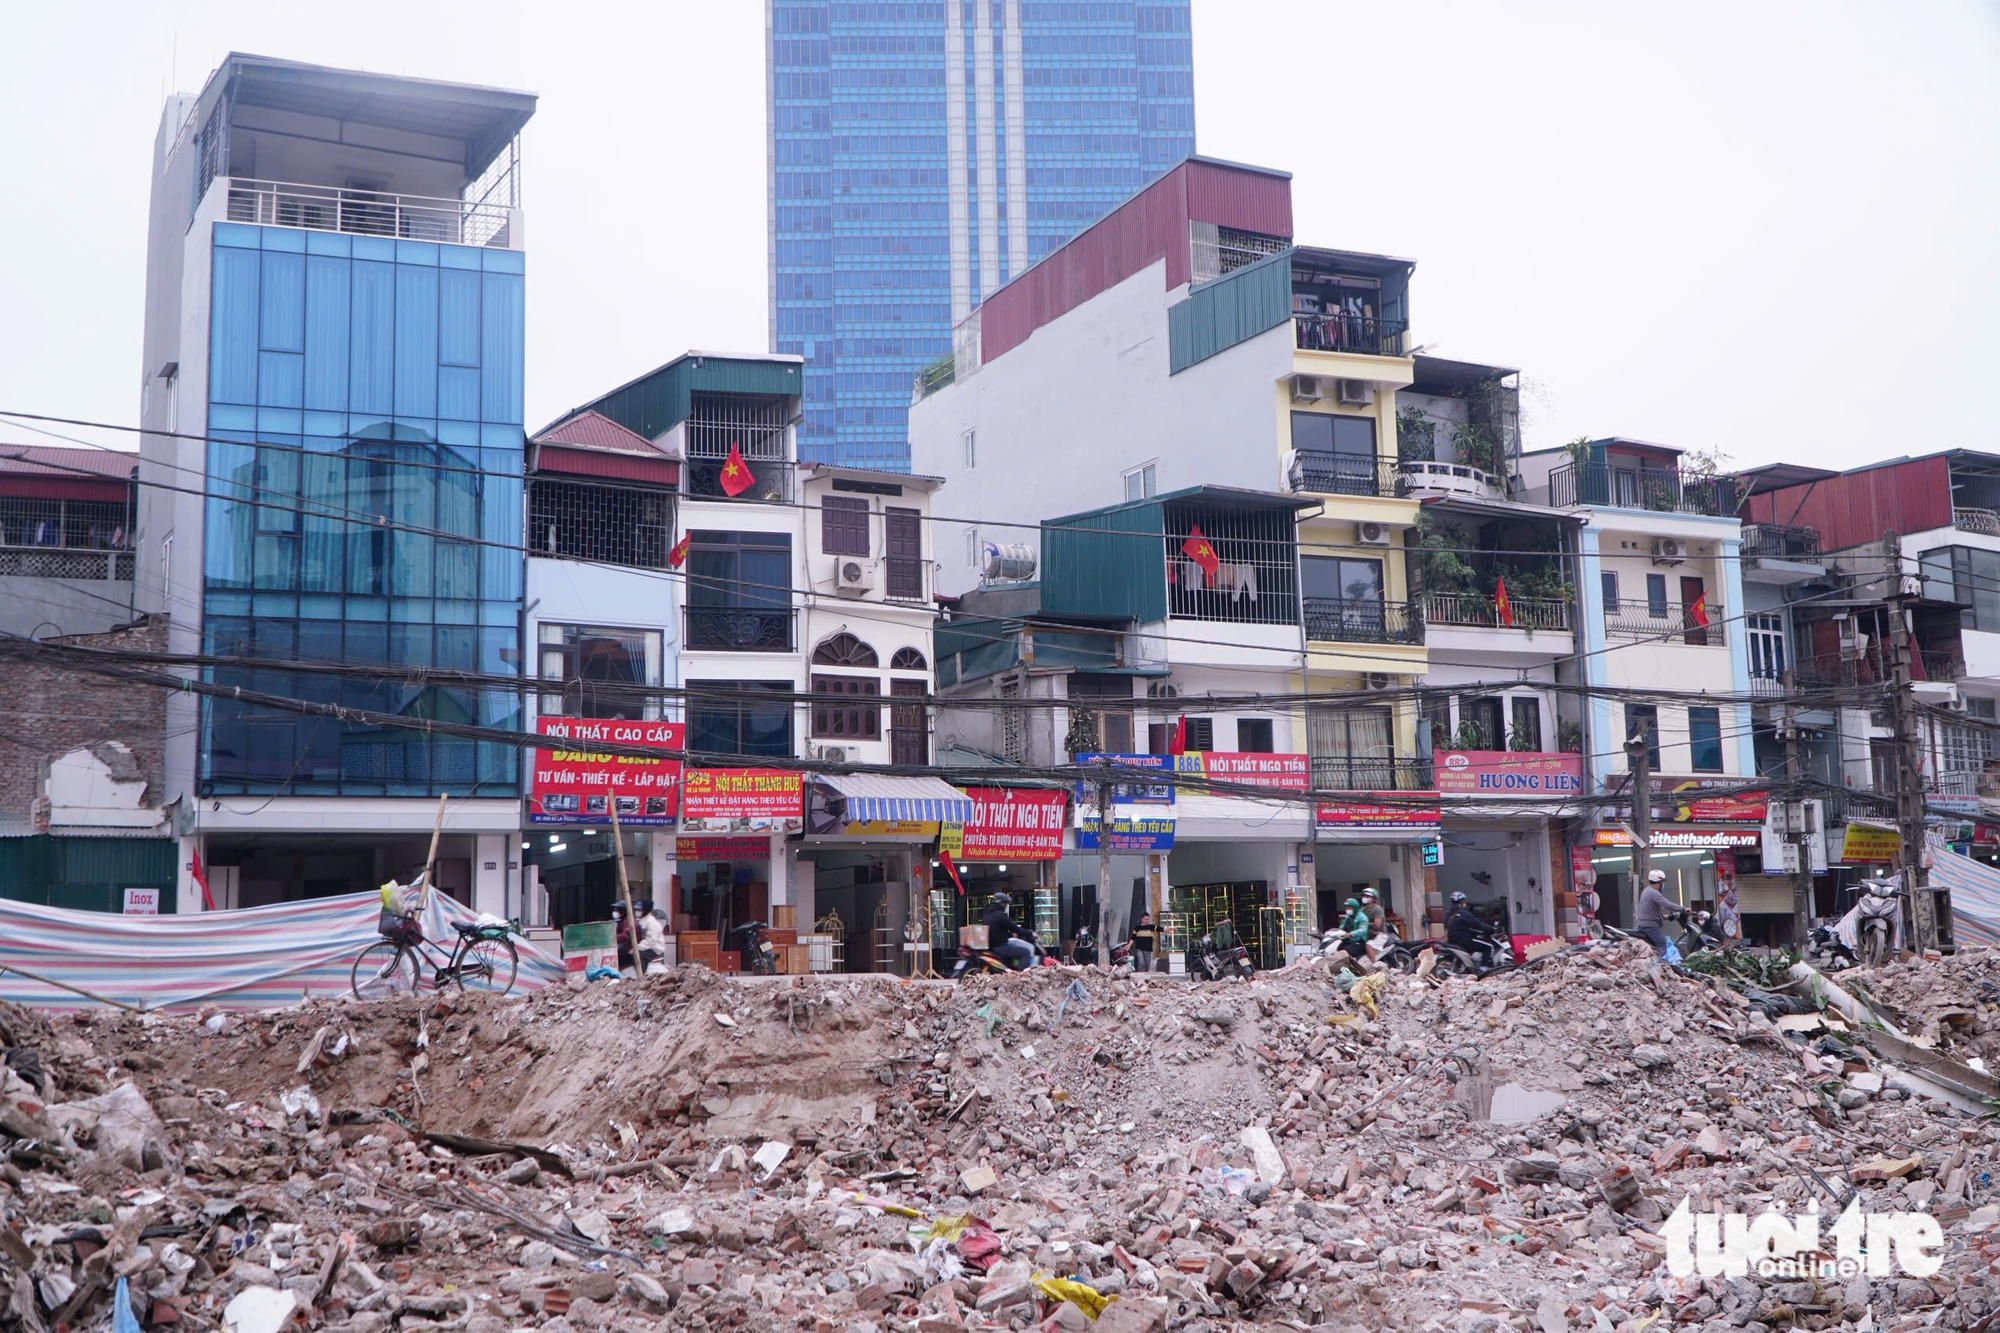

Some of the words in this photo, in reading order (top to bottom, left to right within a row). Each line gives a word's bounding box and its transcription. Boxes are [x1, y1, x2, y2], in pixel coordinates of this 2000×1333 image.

[615, 728, 641, 741] CAO
[647, 726, 673, 742] CẤP
[1126, 758, 1142, 766] DUY
[1143, 756, 1162, 766] KIÊN
[1179, 757, 1200, 772] 886
[1210, 758, 1229, 775] NỘI
[1231, 755, 1257, 772] THẤT
[1259, 760, 1281, 774] NGA
[1449, 758, 1465, 766] 882
[1500, 756, 1522, 769] Salon
[538, 771, 553, 782] TƯ
[554, 769, 574, 783] VẤN
[582, 770, 610, 785] THIẾT
[612, 770, 626, 785] KẾ
[635, 771, 655, 786] LẮP
[656, 774, 676, 787] ĐẶT
[715, 773, 730, 796] NỘI
[731, 770, 753, 791] THẤT
[754, 773, 781, 791] THÀNH
[1480, 773, 1540, 788] HƯƠNG
[1545, 772, 1581, 789] LIÊN
[686, 795, 702, 806] NHẬN
[703, 795, 719, 805] THIẾT
[720, 795, 728, 804] KẾ
[729, 796, 741, 806] ĐẶT
[742, 796, 759, 805] HÀNG
[760, 796, 775, 804] THEO
[776, 795, 787, 804] YÊU
[988, 799, 1015, 827] THẤT
[1016, 804, 1039, 828] NGA
[1041, 797, 1063, 829] TIẾN
[1131, 822, 1146, 833] THEO
[1148, 820, 1159, 833] YÊU
[1161, 819, 1173, 833] CẦU
[964, 834, 988, 845] CHUYÊN:
[989, 833, 996, 846] TỦ
[996, 835, 1010, 848] RƯỢU
[987, 849, 998, 857] đặt
[999, 848, 1015, 857] hàng
[1031, 850, 1042, 858] yêu
[1044, 848, 1056, 857] cầu
[129, 892, 153, 904] Inox
